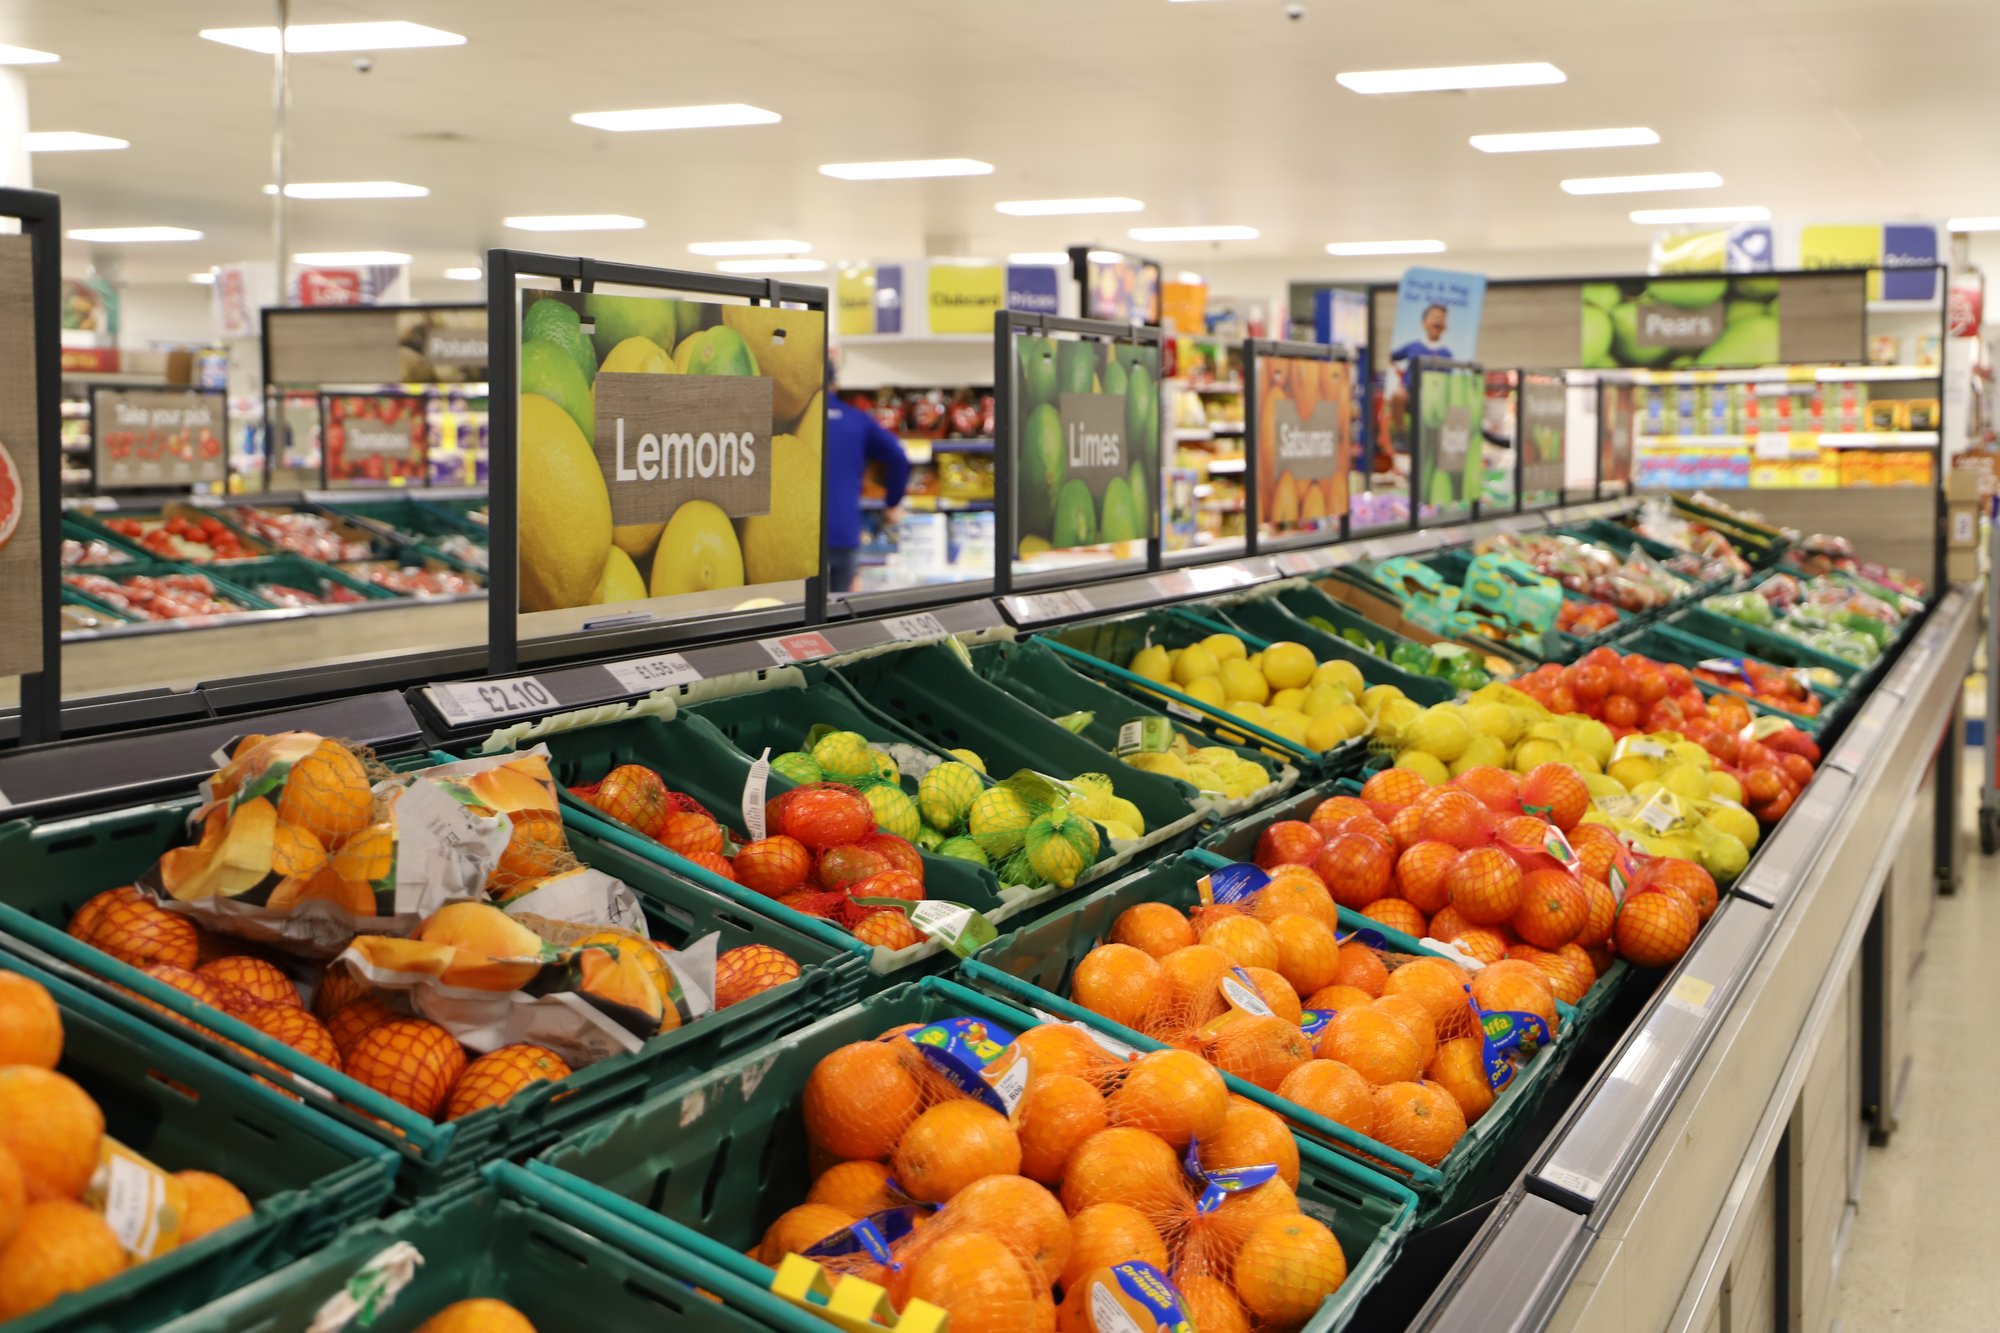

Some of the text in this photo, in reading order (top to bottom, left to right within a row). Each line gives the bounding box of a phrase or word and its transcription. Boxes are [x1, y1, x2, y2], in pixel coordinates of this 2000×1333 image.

[929, 291, 1000, 308] Clubcard
[1645, 311, 1713, 338] Pears
[115, 403, 212, 430] Take your pick
[616, 418, 756, 482] Lemons
[1069, 421, 1120, 467] Limes
[1280, 421, 1334, 458] Satsumas
[899, 615, 943, 638] £1.90
[635, 661, 675, 679] £1.55
[477, 680, 550, 713] £2.10
[1121, 1264, 1173, 1309] Oranges
[1138, 1269, 1172, 1297] Juicy
